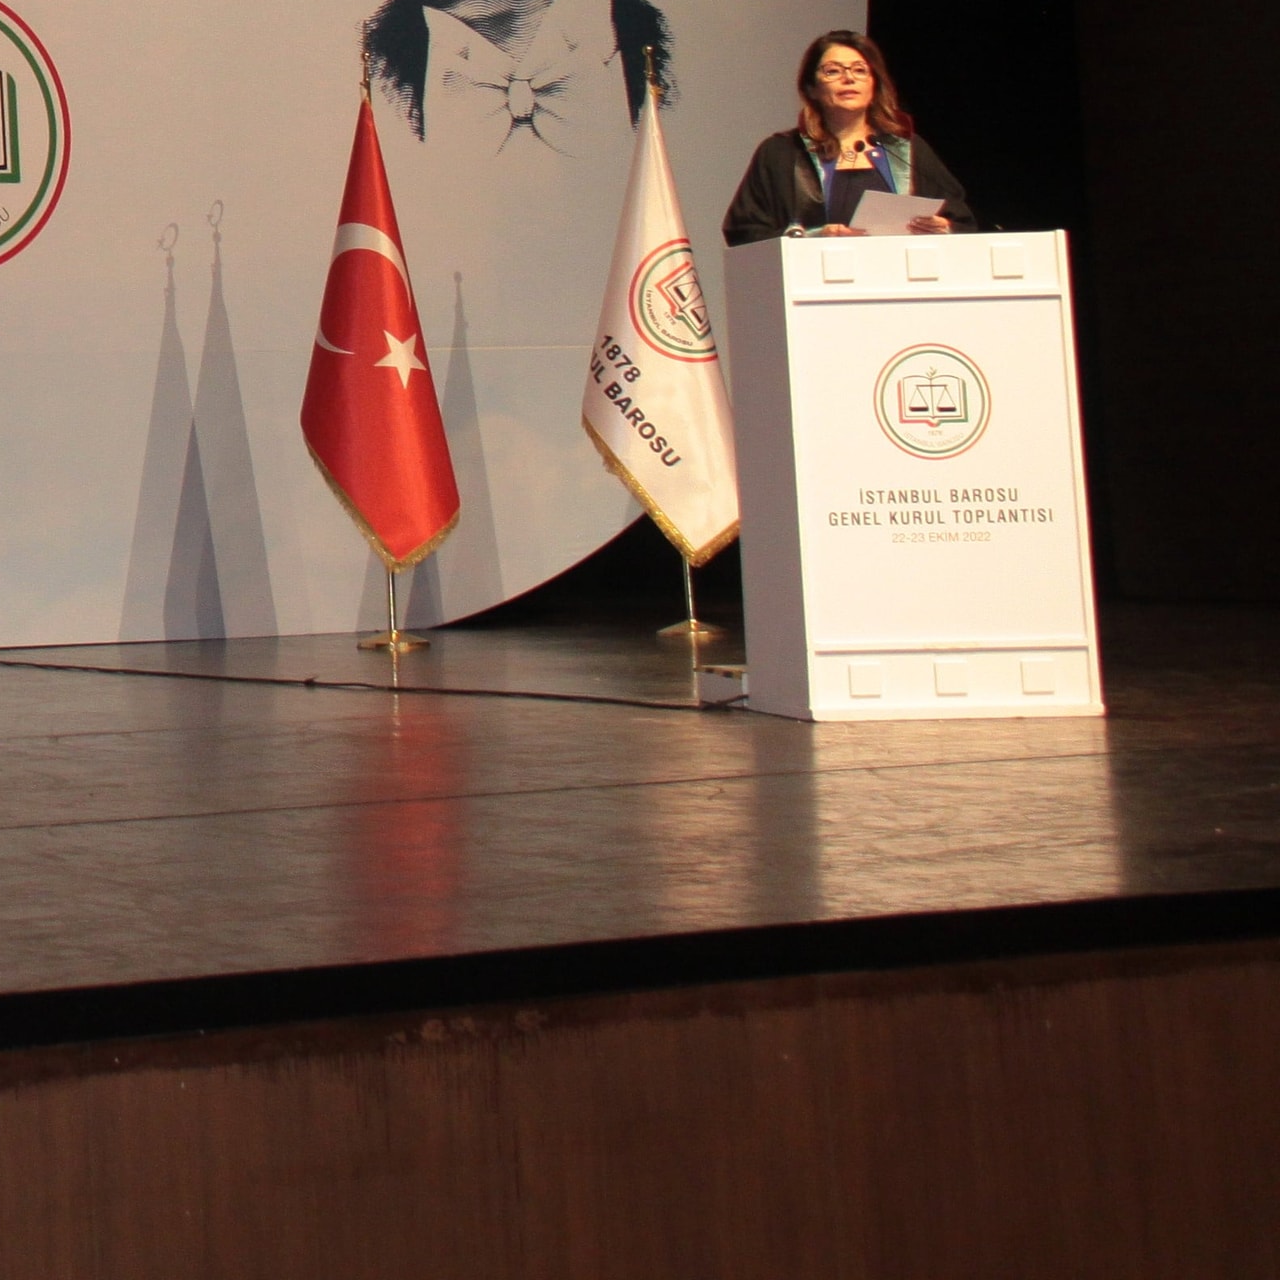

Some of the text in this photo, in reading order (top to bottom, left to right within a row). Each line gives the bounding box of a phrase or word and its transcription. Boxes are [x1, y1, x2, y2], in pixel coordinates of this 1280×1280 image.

[600, 334, 642, 383] 1878
[603, 381, 682, 467] BAROSU
[859, 487, 1020, 505] İSTANBUL BAROSU
[828, 508, 1055, 527] GENEL KURUL TOPLANTISI
[891, 530, 992, 544] 22-23 EKİM 2022
